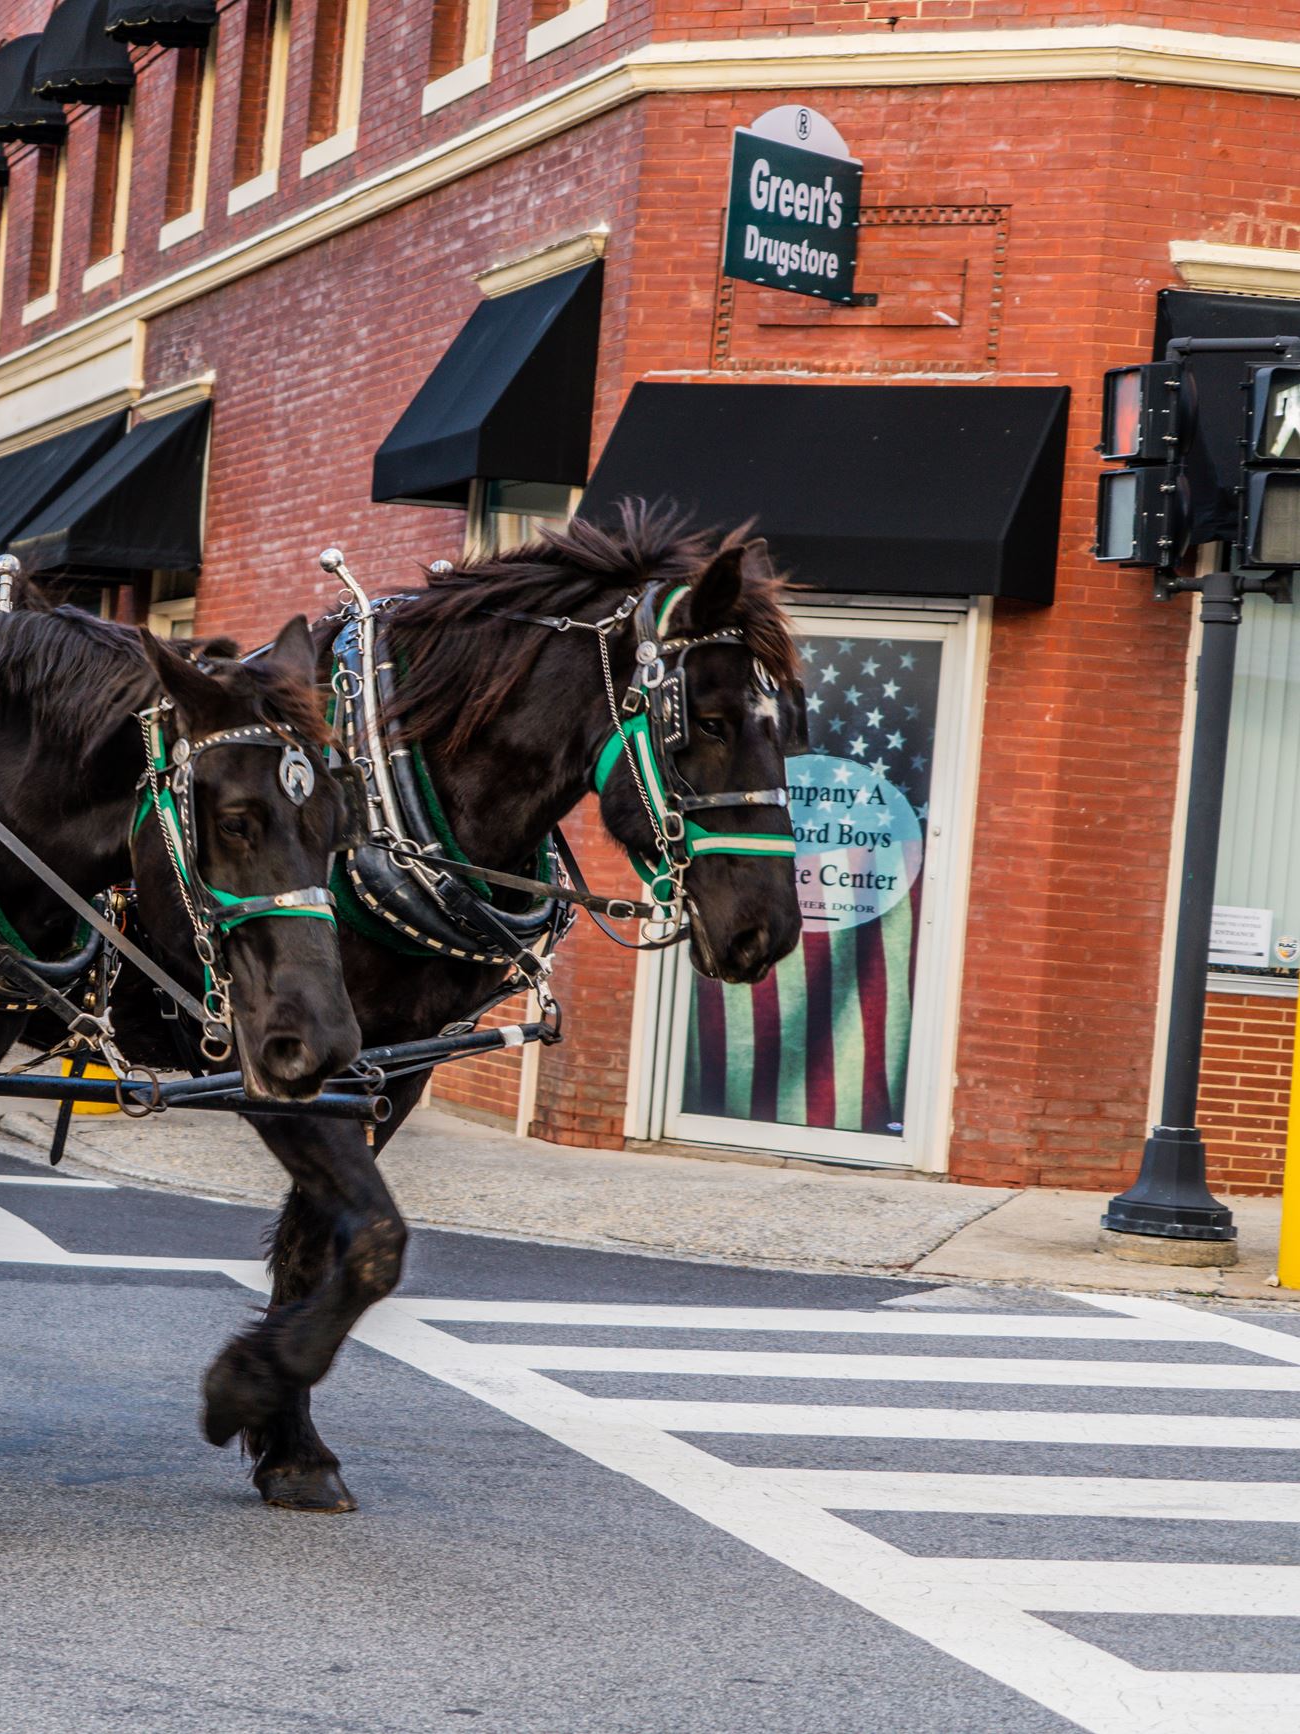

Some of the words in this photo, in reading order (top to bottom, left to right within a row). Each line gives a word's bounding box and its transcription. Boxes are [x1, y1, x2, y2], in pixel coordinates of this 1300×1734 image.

[750, 158, 843, 229] Green's
[744, 224, 839, 278] Drugstore
[787, 785, 860, 809] mpany
[867, 784, 887, 806] A
[837, 823, 892, 852] Boys
[819, 864, 897, 891] Center
[799, 900, 826, 910] HER
[832, 902, 875, 914] DOOR
